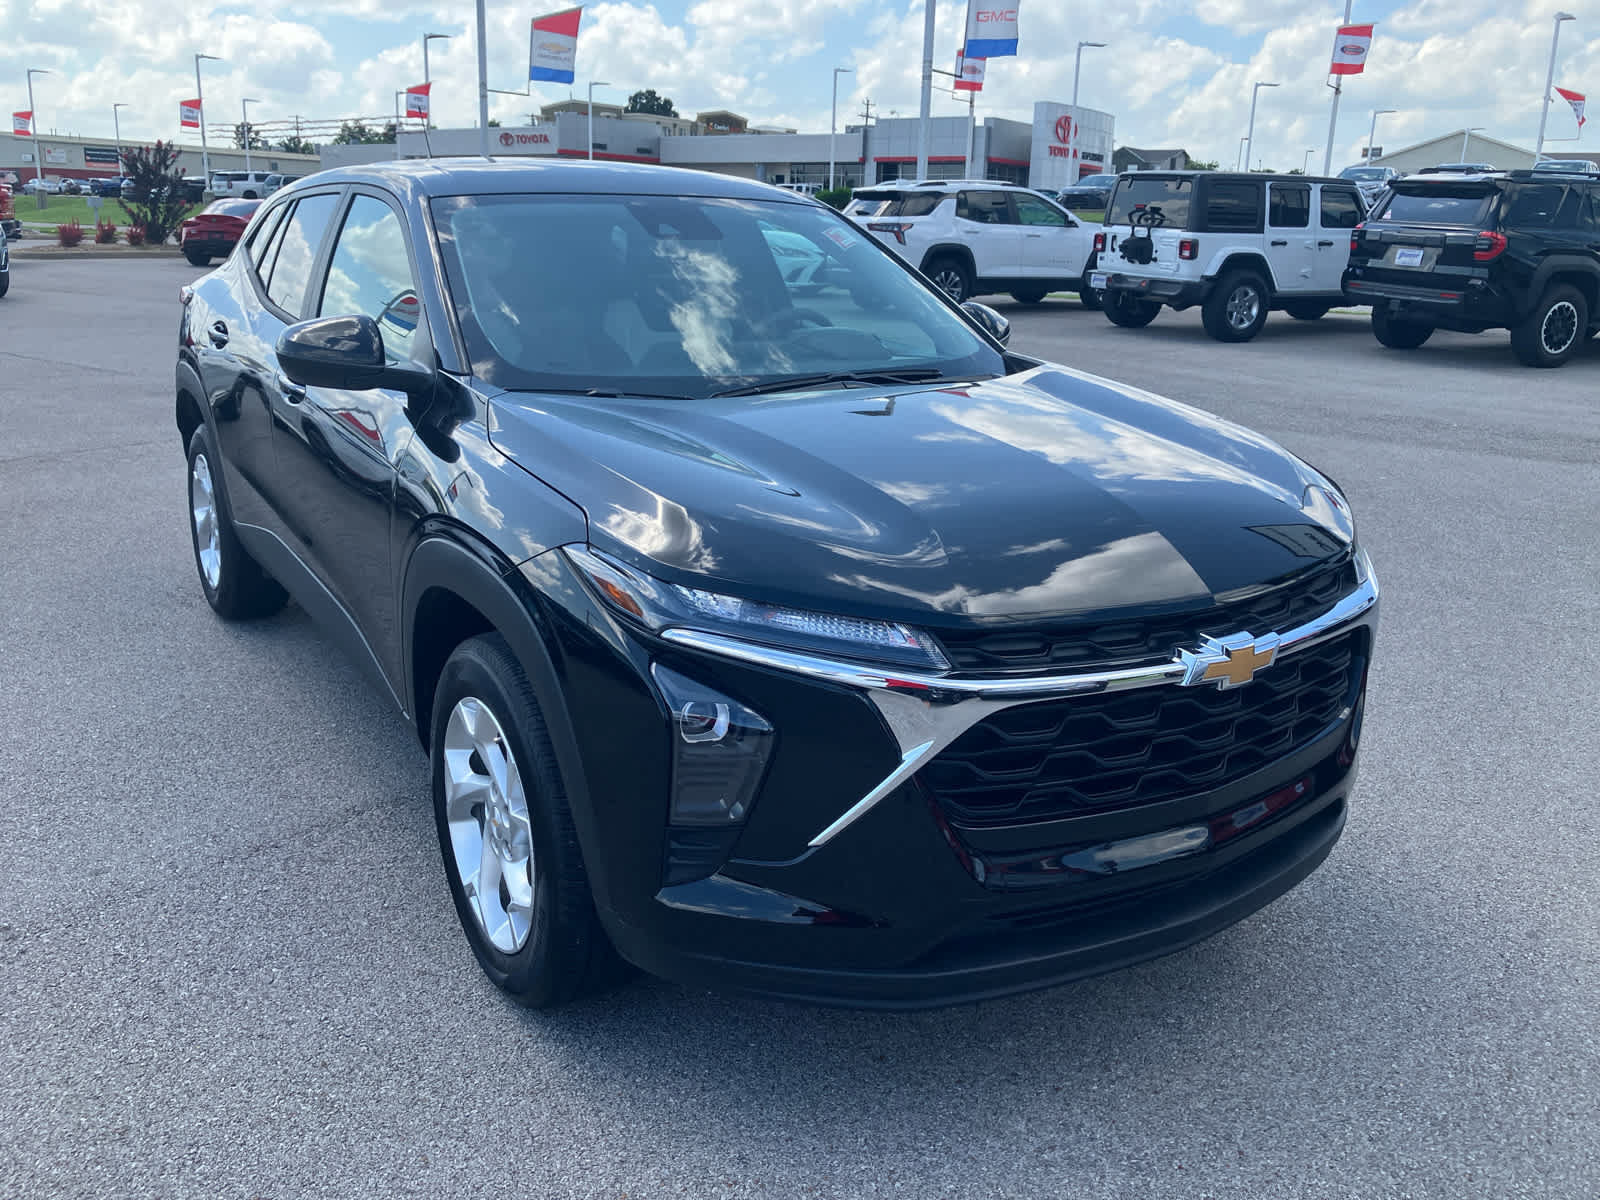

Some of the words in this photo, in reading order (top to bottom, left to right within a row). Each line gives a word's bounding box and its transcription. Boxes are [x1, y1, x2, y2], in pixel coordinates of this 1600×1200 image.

[976, 10, 1016, 22] GMC
[515, 134, 550, 144] TOYOTA
[1048, 145, 1077, 159] TOYOA
